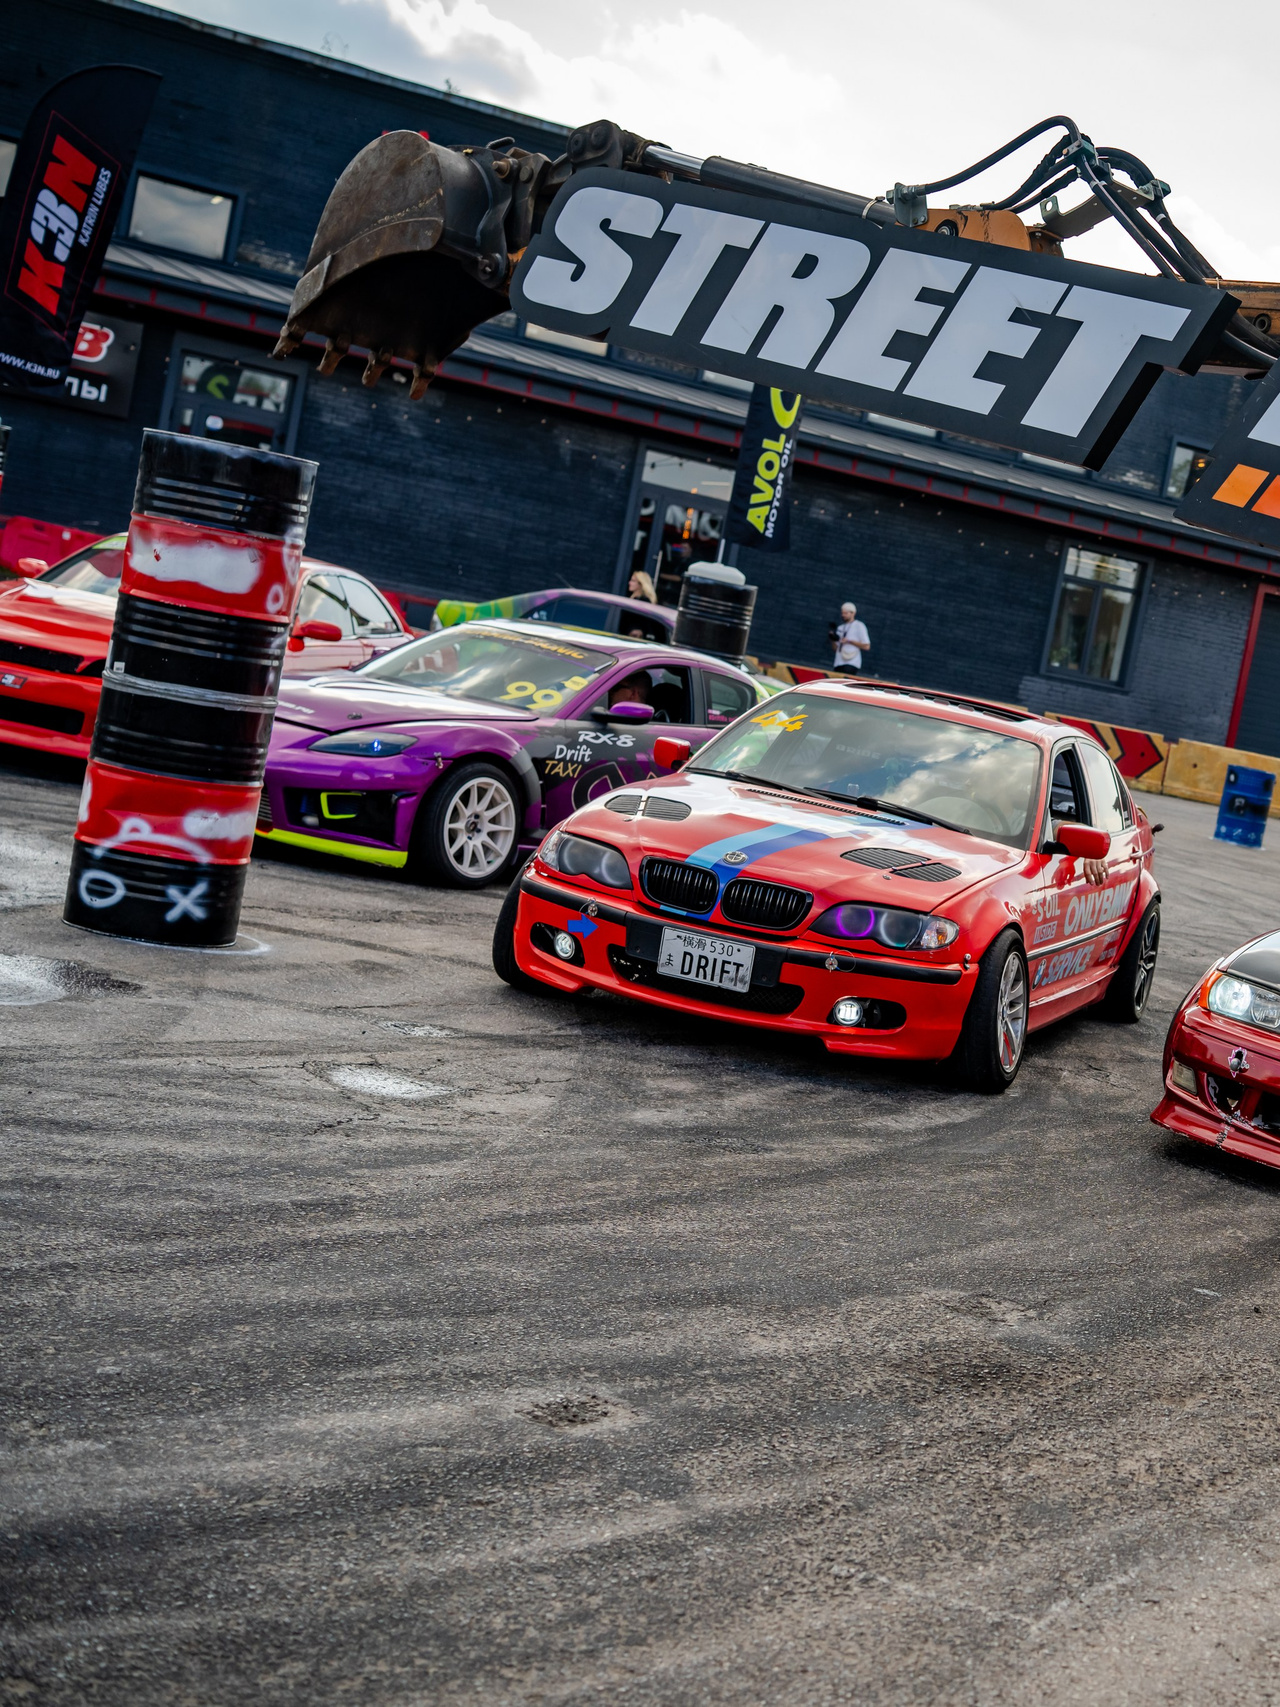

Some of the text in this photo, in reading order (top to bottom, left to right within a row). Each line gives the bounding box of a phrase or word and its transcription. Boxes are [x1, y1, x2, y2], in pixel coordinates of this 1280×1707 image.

[78, 167, 112, 247] KATRIN LUBES
[17, 134, 97, 316] K3N
[522, 186, 1192, 438] STREET
[764, 472, 785, 538] MOTOR
[781, 439, 793, 467] OIL
[500, 681, 563, 710] 99
[749, 709, 809, 732] 44
[554, 744, 592, 763] Drift
[577, 730, 636, 747] RX-8
[544, 760, 582, 779] TAXI
[709, 940, 734, 957] 530
[679, 951, 744, 987] DRIFT
[1041, 943, 1096, 987] SERVICE
